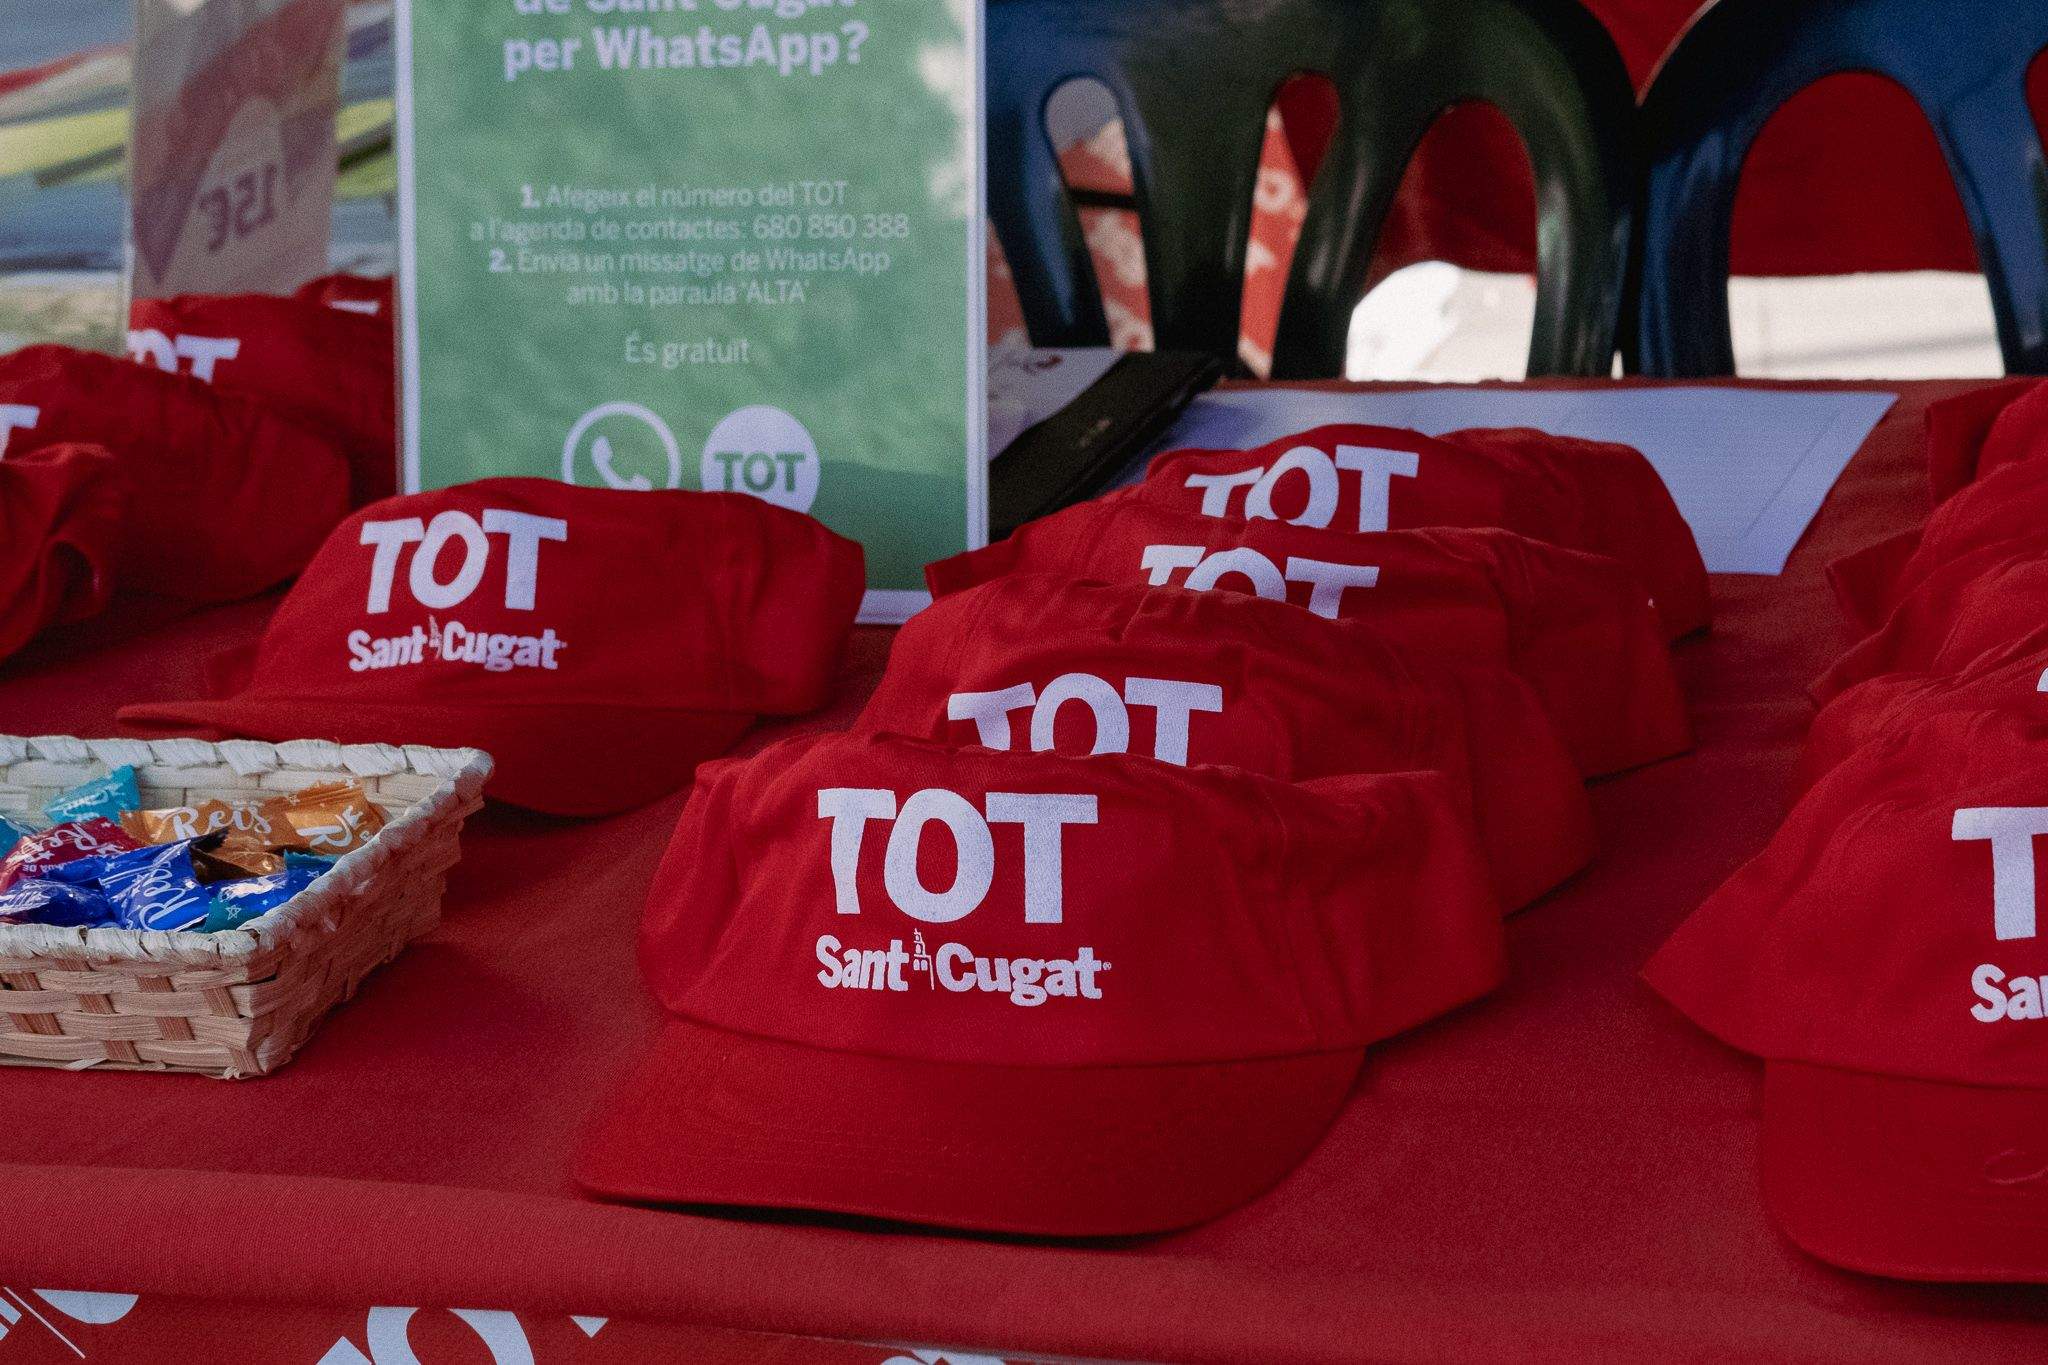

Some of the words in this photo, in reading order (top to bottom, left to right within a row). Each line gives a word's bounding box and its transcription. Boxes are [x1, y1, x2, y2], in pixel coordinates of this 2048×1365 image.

[503, 38, 582, 81] per
[591, 21, 869, 76] WhatsApp?
[520, 183, 541, 208] 1.
[634, 184, 656, 208] el
[661, 183, 753, 207] número
[757, 182, 794, 206] del
[798, 180, 848, 206] TOT
[470, 222, 484, 241] a
[590, 217, 620, 241] de
[752, 213, 803, 239] 680
[806, 213, 857, 239] 850
[861, 213, 910, 239] 388
[487, 248, 513, 273] 2.
[583, 253, 613, 273] un
[618, 250, 725, 278] missatge
[729, 249, 761, 273] de
[764, 247, 890, 277] WhatsApp
[566, 281, 617, 305] amb
[624, 281, 643, 304] la
[648, 281, 737, 309] paraula
[625, 330, 657, 363] És
[714, 451, 806, 492] TOT
[1185, 444, 1419, 533] TOT
[360, 508, 568, 614] TOT
[1140, 544, 1380, 620] TOT
[347, 625, 428, 672] Sant
[948, 672, 1223, 766] TOT
[817, 787, 1098, 923] TOT
[816, 935, 909, 991] Sant
